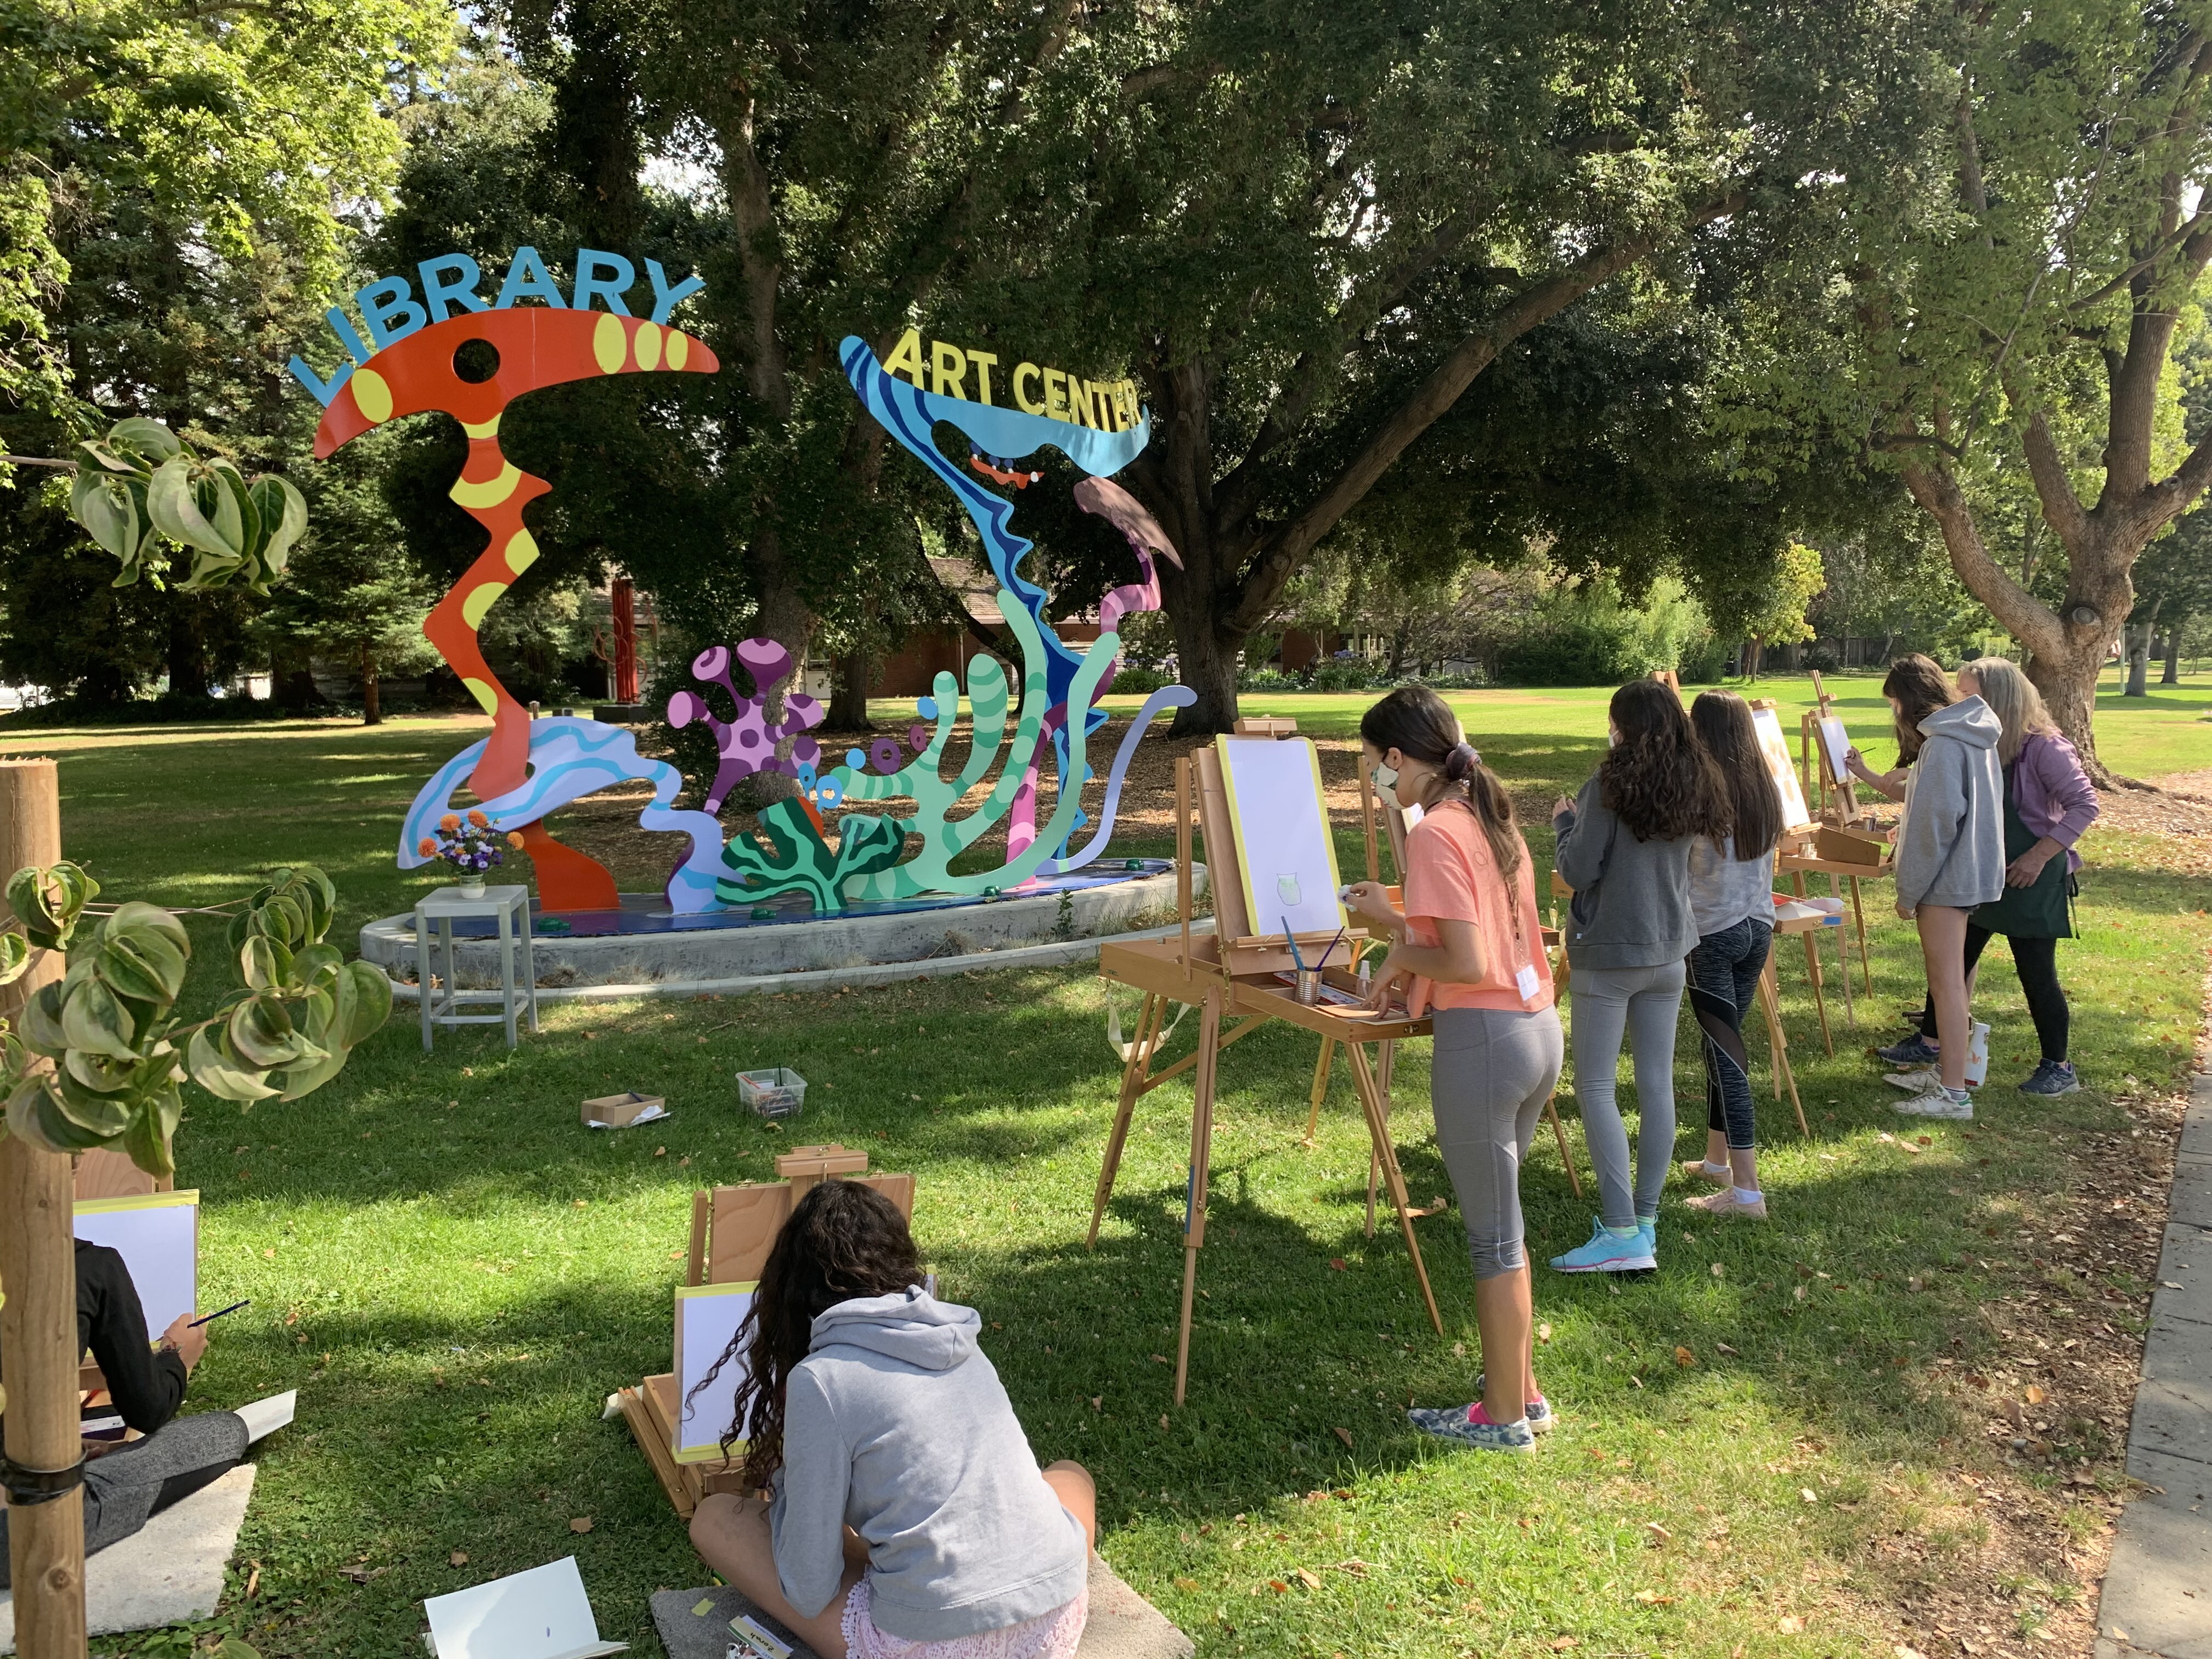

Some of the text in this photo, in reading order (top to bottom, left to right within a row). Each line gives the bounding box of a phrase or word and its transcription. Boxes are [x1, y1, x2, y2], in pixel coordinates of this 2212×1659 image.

[288, 246, 707, 408] LIBRARY
[883, 328, 1142, 432] ART CENTER
